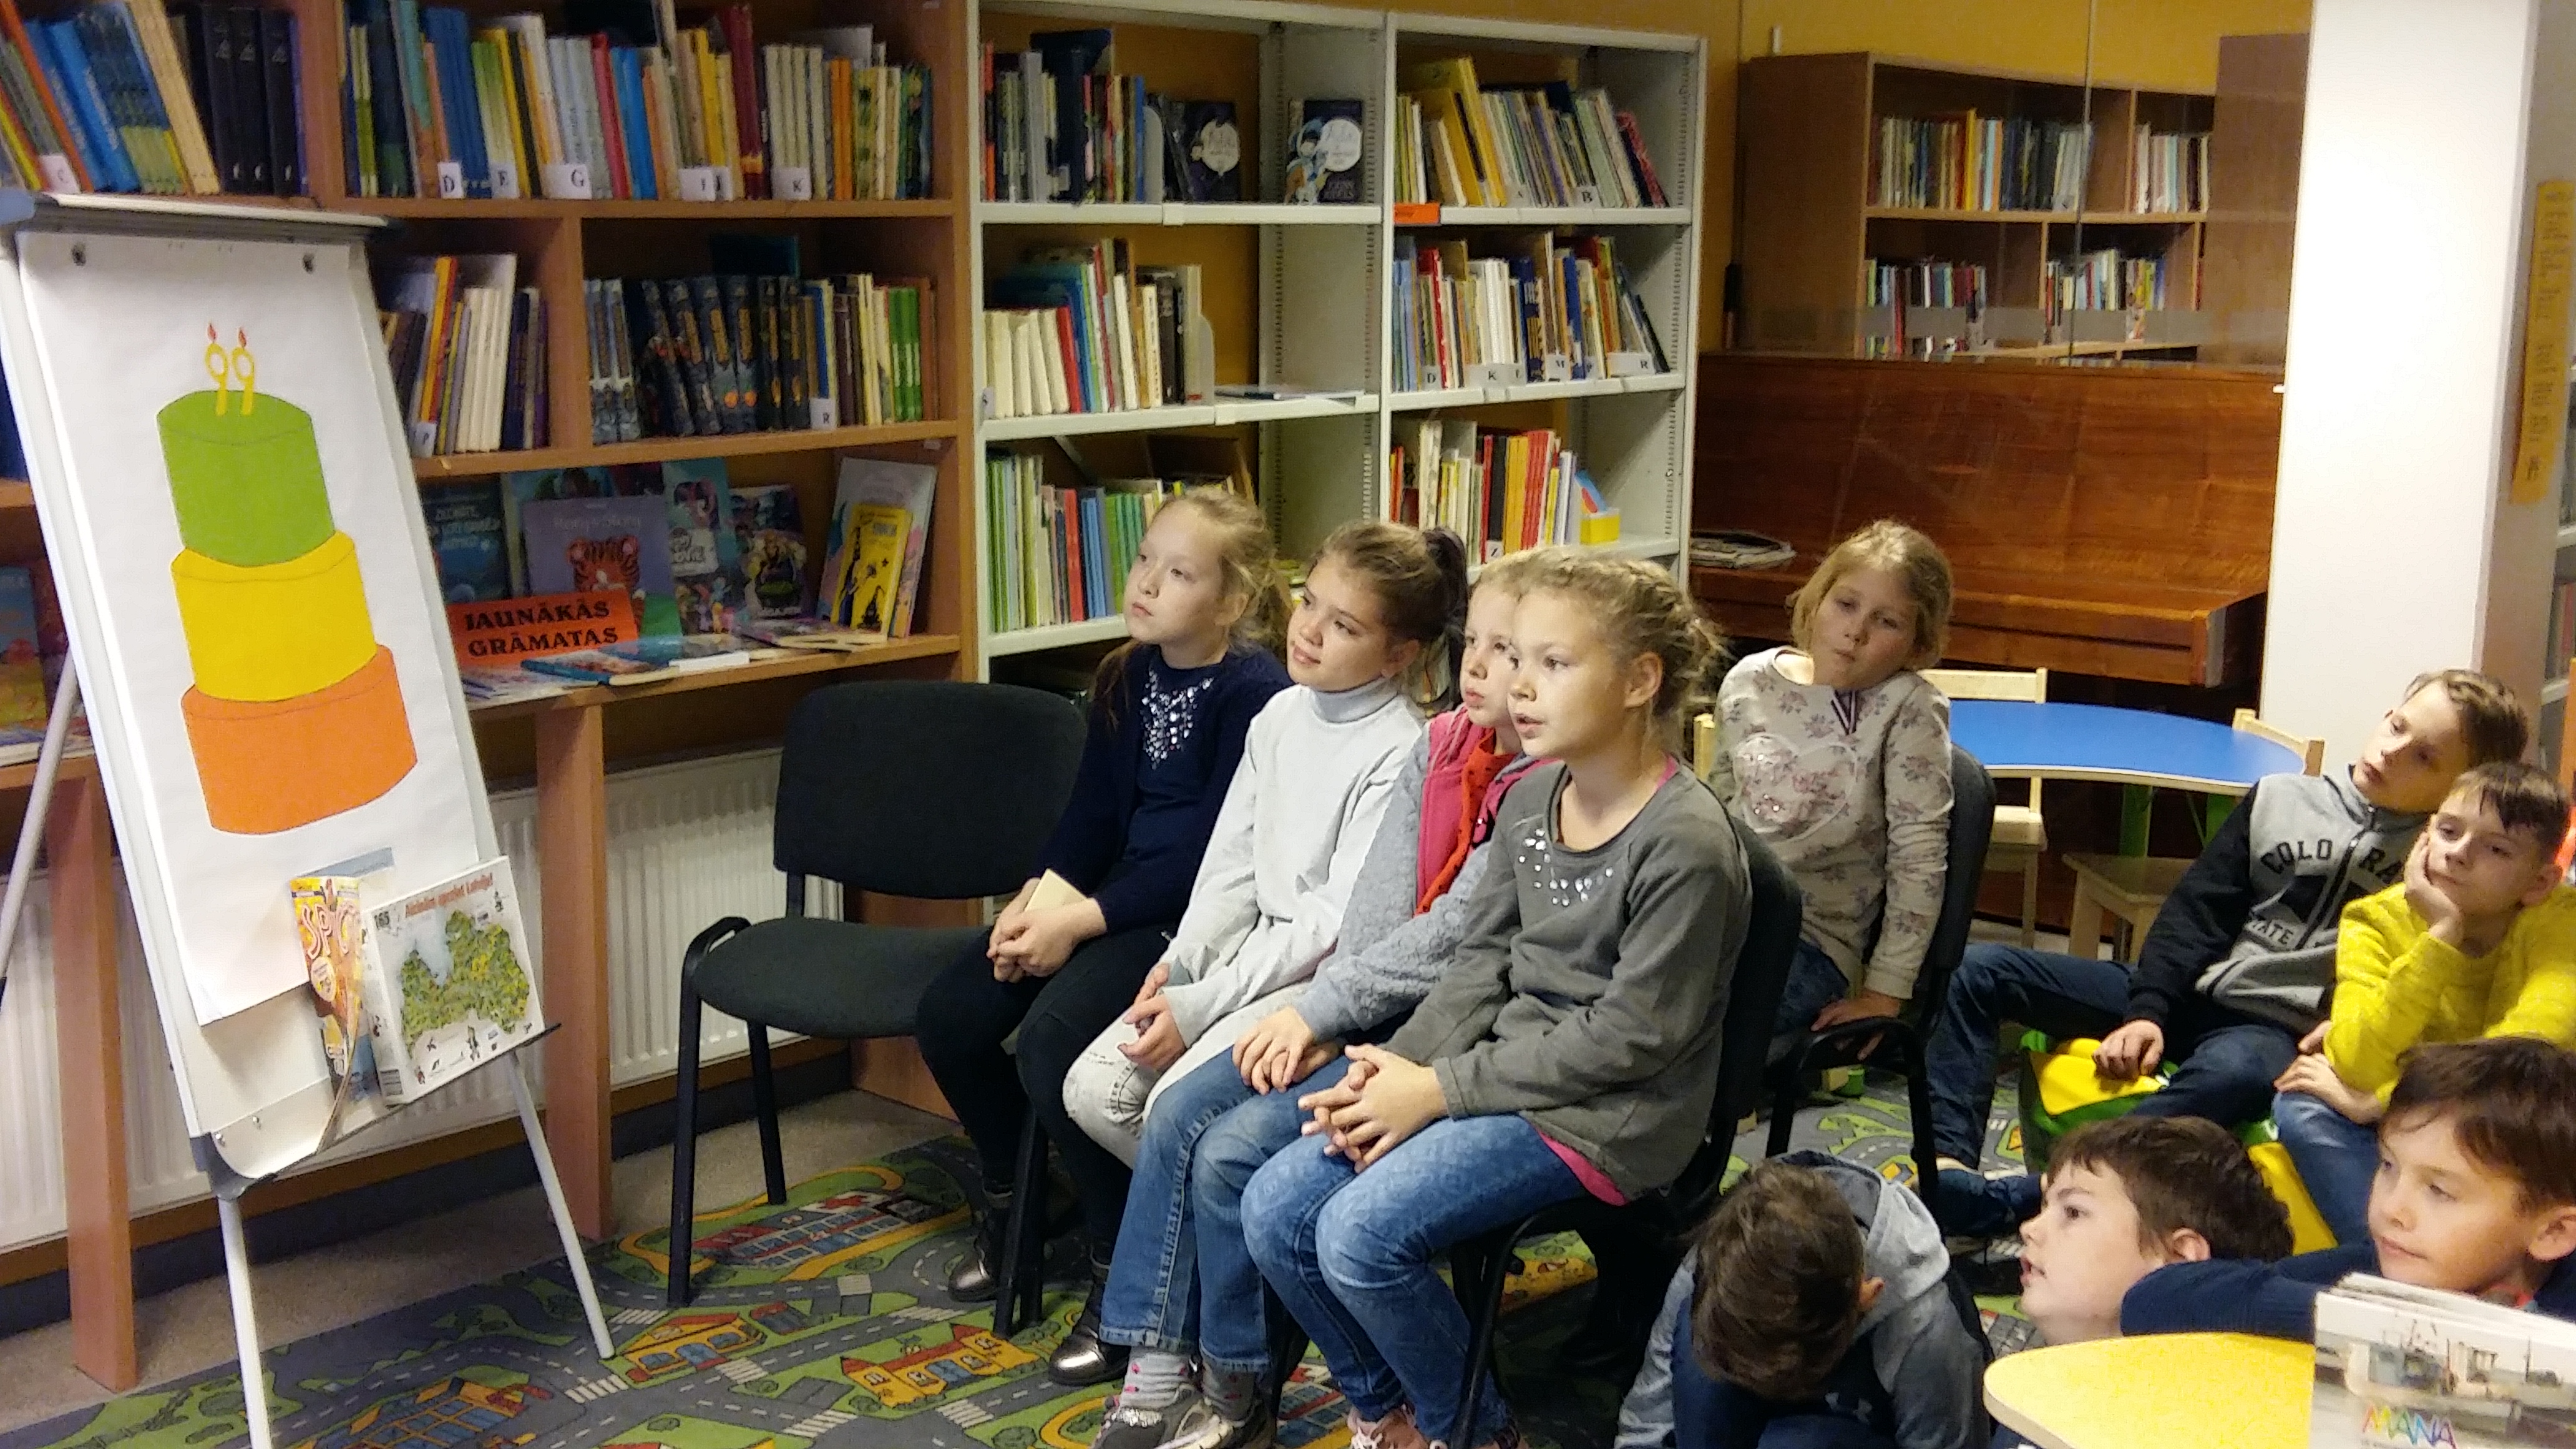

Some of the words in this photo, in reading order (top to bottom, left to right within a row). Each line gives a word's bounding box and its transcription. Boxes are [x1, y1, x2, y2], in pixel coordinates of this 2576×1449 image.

[442, 175, 455, 193] D
[571, 168, 584, 187] G
[793, 177, 804, 193] K
[1581, 191, 1593, 203] B
[1640, 359, 1648, 369] R
[1427, 373, 1436, 383] D
[1488, 371, 1496, 381] K
[822, 412, 830, 424] R
[422, 432, 429, 446] P
[464, 598, 610, 632] JAUNĀKĀS
[468, 627, 618, 657] GRĀMATAS
[2260, 839, 2333, 874] COLO
[2362, 1404, 2458, 1449] MANA
